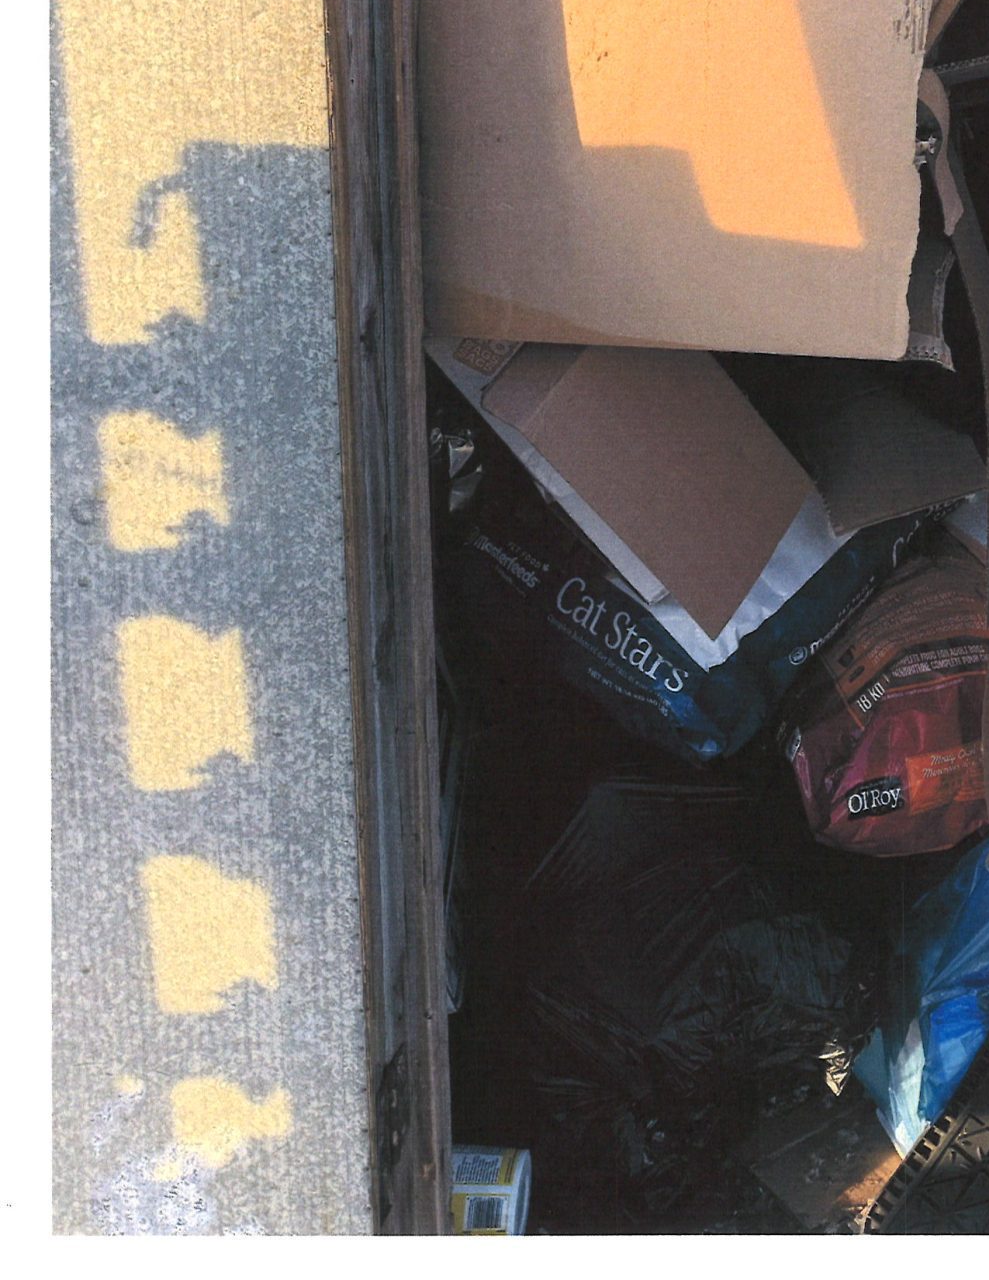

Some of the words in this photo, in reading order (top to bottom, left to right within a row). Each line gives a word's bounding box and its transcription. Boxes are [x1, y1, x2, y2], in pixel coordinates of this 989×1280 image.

[556, 577, 607, 636] Cat
[604, 611, 689, 693] Stars
[856, 694, 872, 713] 18
